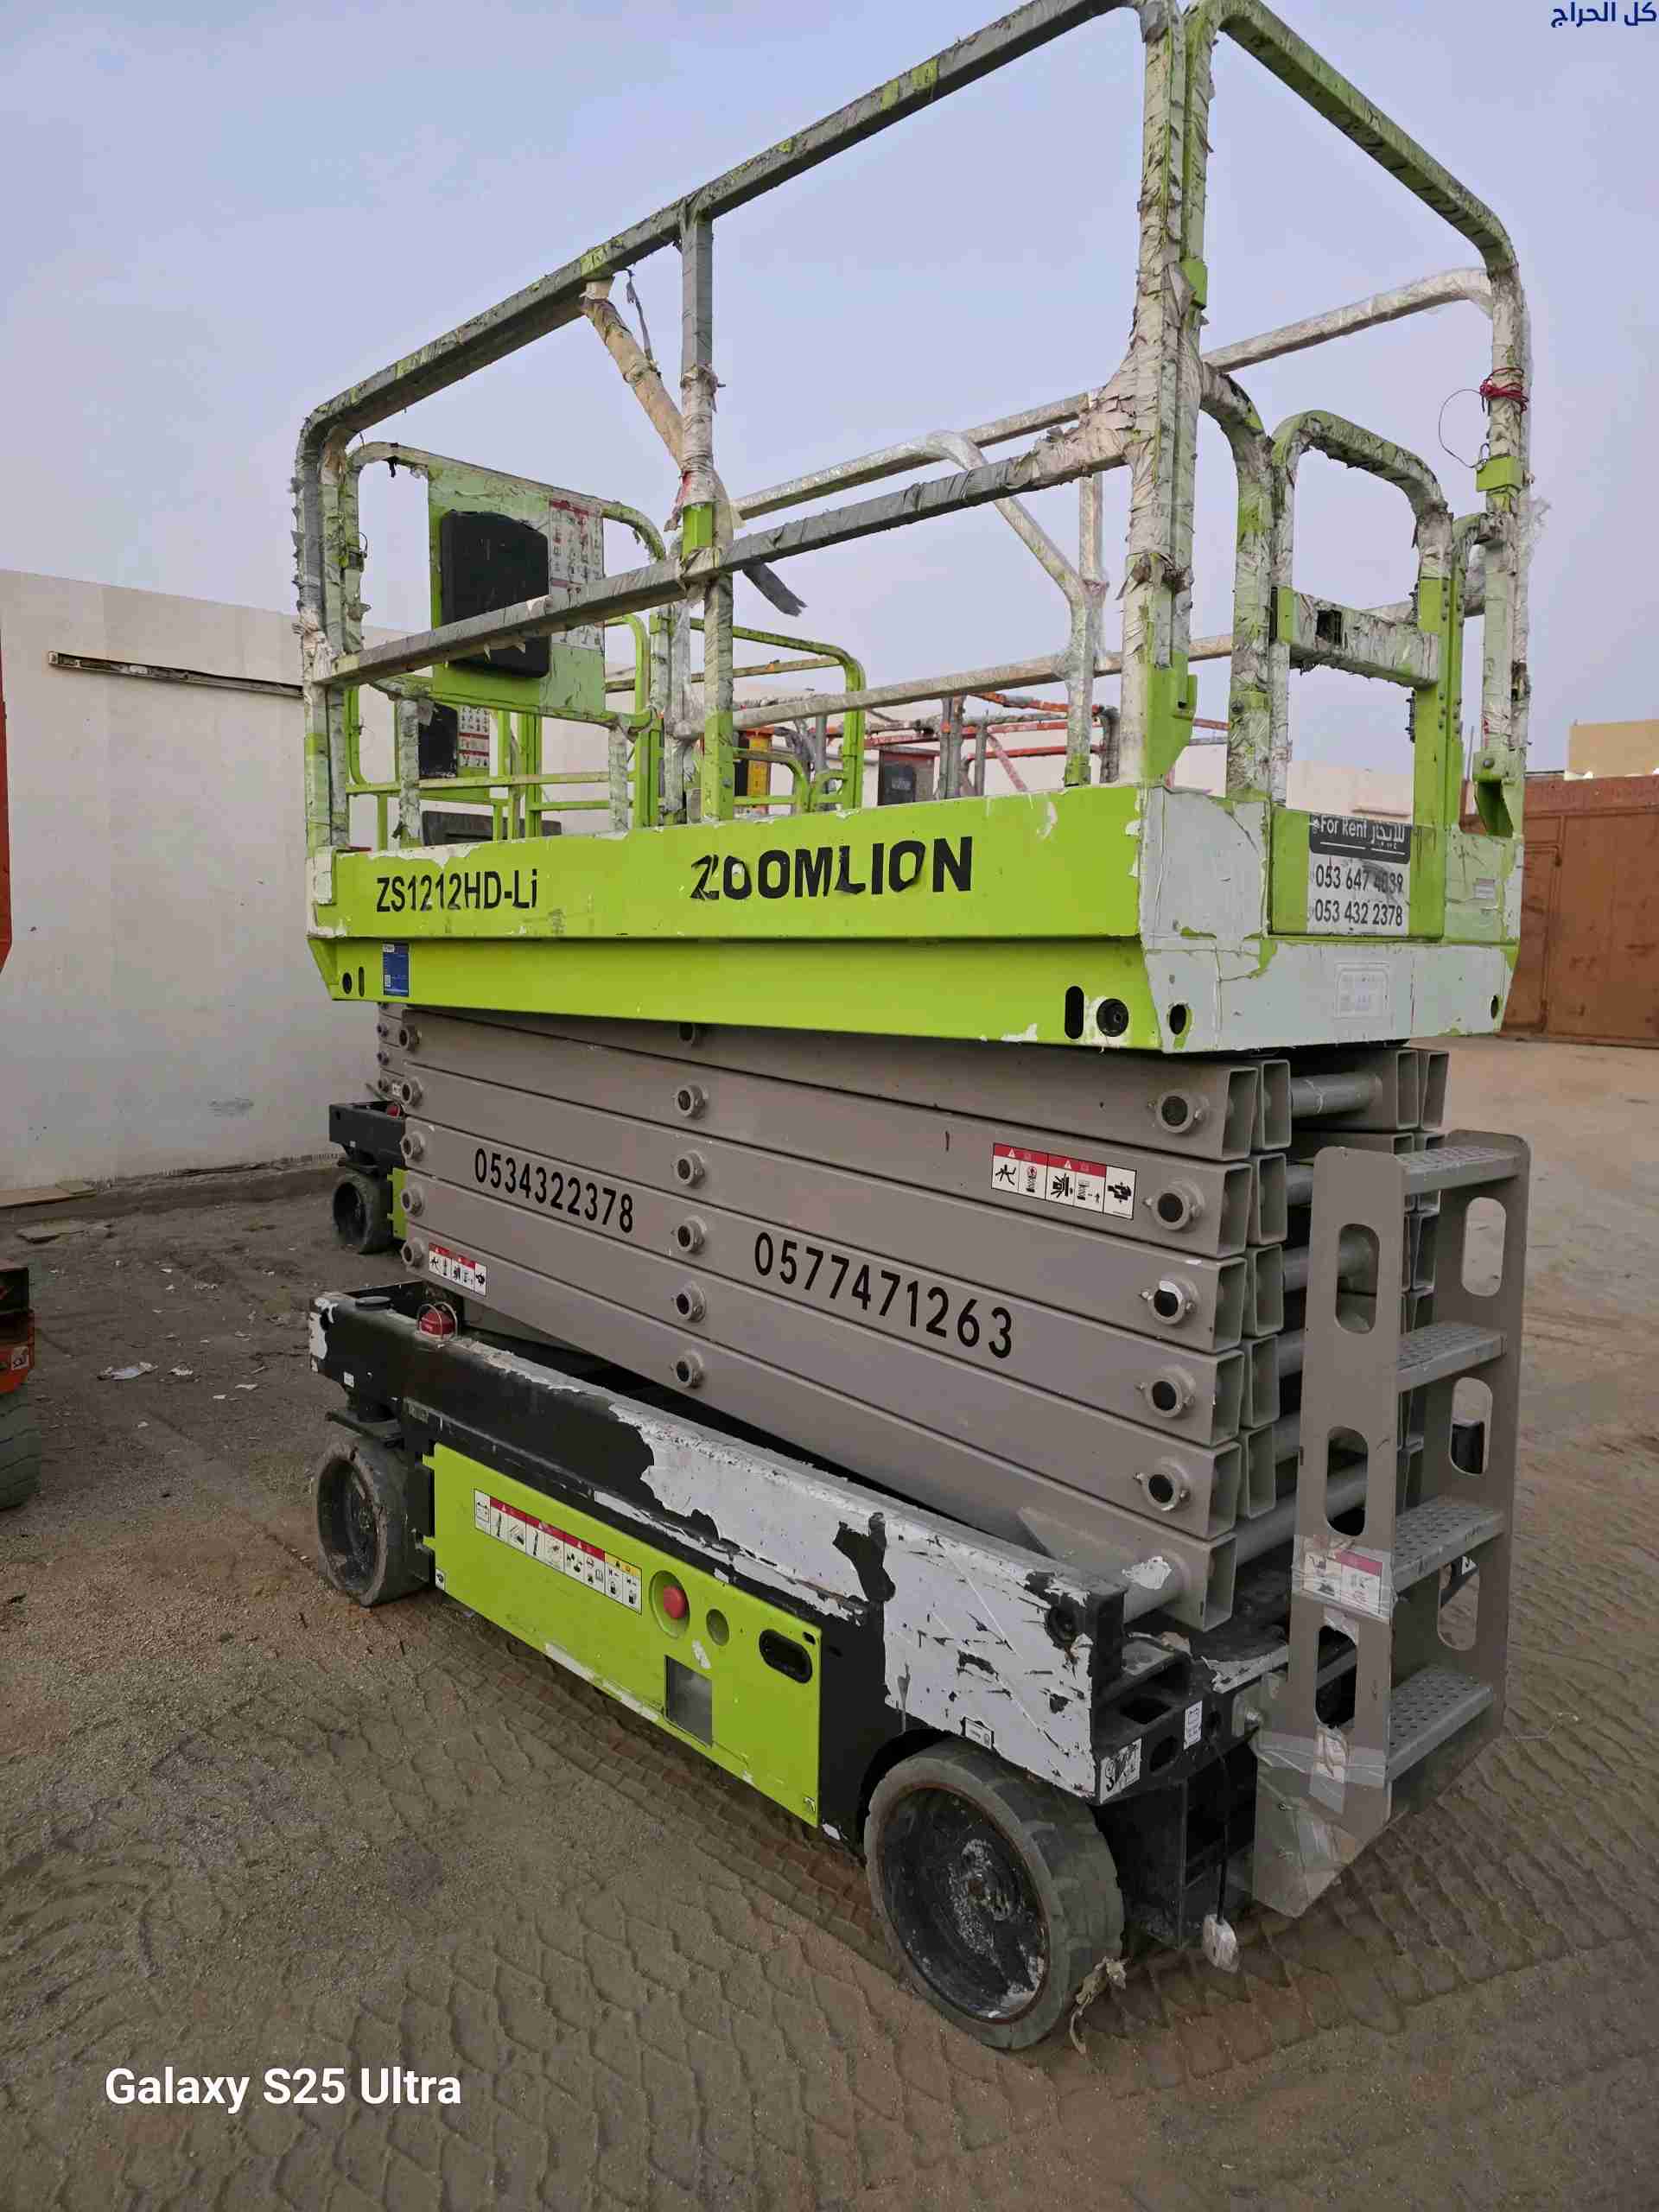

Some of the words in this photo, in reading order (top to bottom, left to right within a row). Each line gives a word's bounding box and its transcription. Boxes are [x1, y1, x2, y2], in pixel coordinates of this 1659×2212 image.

[1320, 815, 1339, 835] For
[1342, 817, 1367, 838] Rent
[376, 868, 537, 913] ZS1212HD-Li
[689, 836, 973, 901] ZOOMLION
[1316, 864, 1341, 888] 053
[1346, 868, 1370, 891] 647
[1315, 899, 1340, 922] 053
[1344, 901, 1369, 924] 432
[1372, 903, 1403, 926] 2378
[474, 1147, 634, 1233] 0534322378
[754, 1231, 1013, 1359] 0577471263
